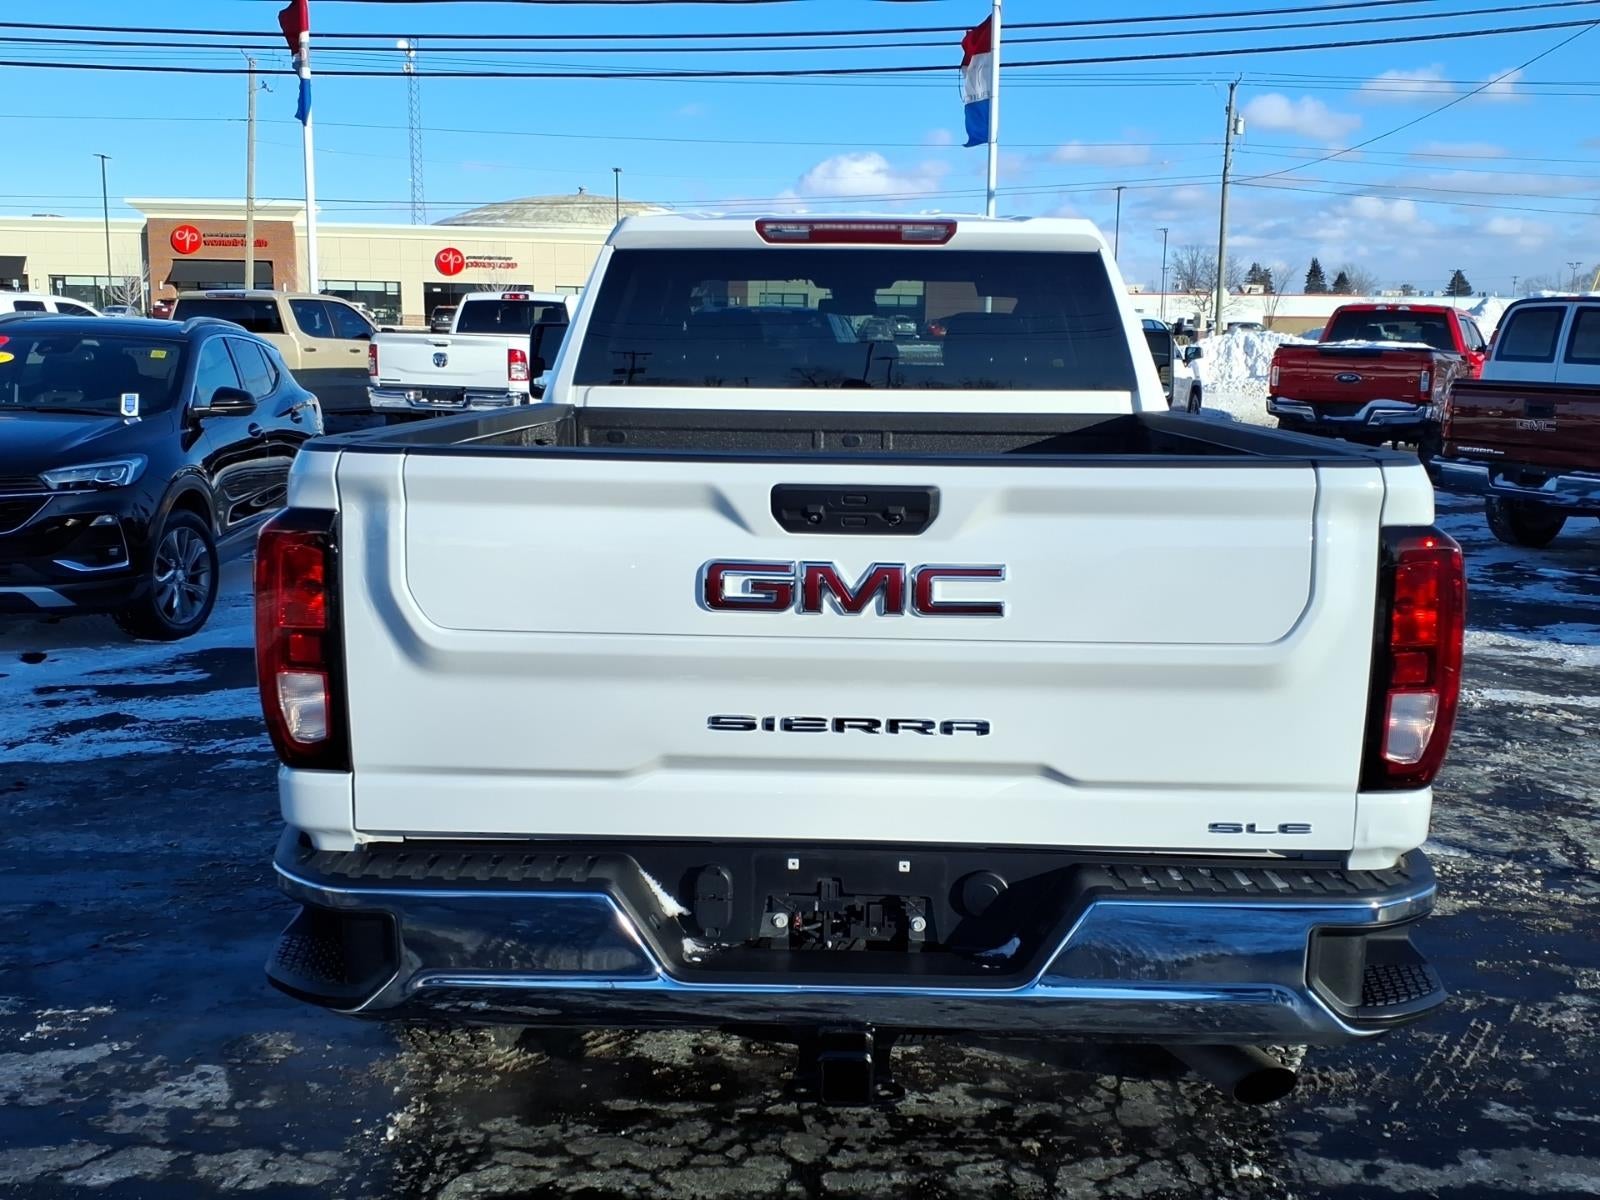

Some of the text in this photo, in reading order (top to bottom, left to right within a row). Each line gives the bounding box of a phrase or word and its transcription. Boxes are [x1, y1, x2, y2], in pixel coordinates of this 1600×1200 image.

[1517, 420, 1556, 431] GMC
[696, 558, 1006, 618] GMC
[707, 714, 991, 736] SIERRA
[1208, 822, 1312, 834] SLE
